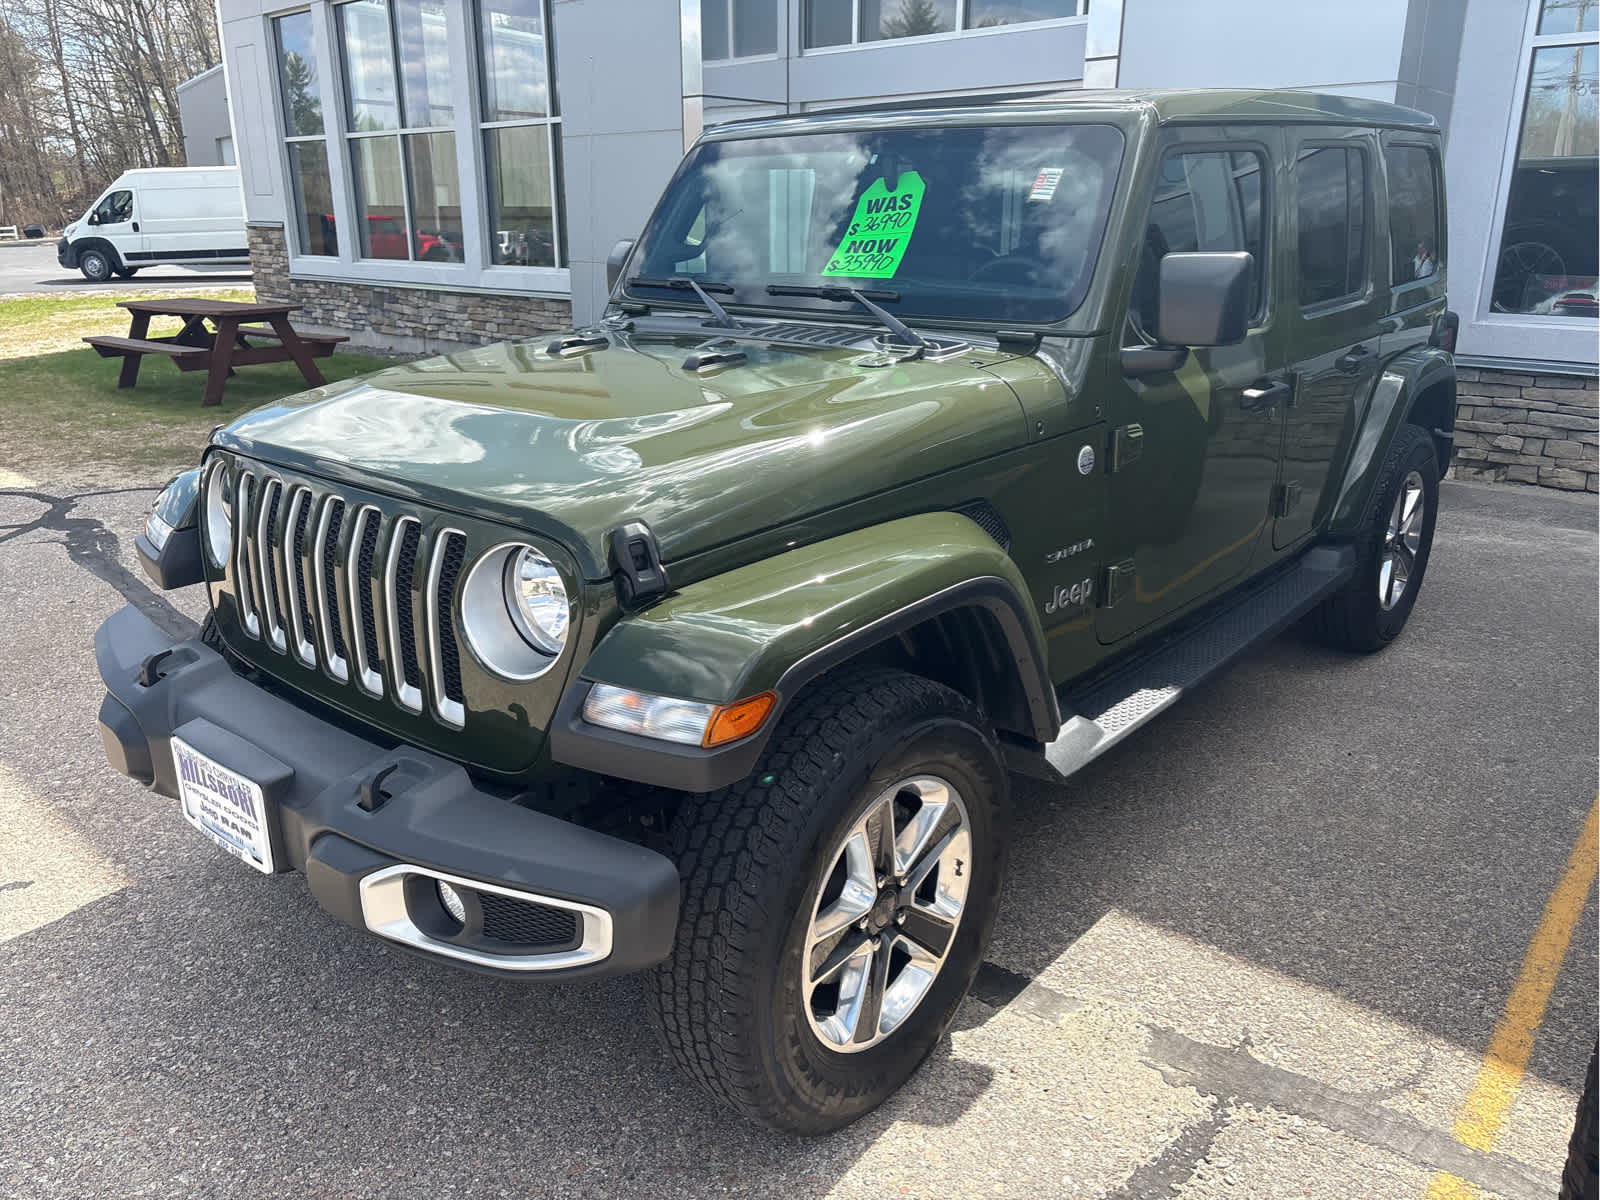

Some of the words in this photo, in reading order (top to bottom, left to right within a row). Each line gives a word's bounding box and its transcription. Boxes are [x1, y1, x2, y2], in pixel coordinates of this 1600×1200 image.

[866, 194, 913, 214] WAS
[845, 239, 899, 254] NOW
[1045, 578, 1093, 614] Jeep
[200, 800, 219, 820] Jeep
[220, 815, 253, 841] RAM
